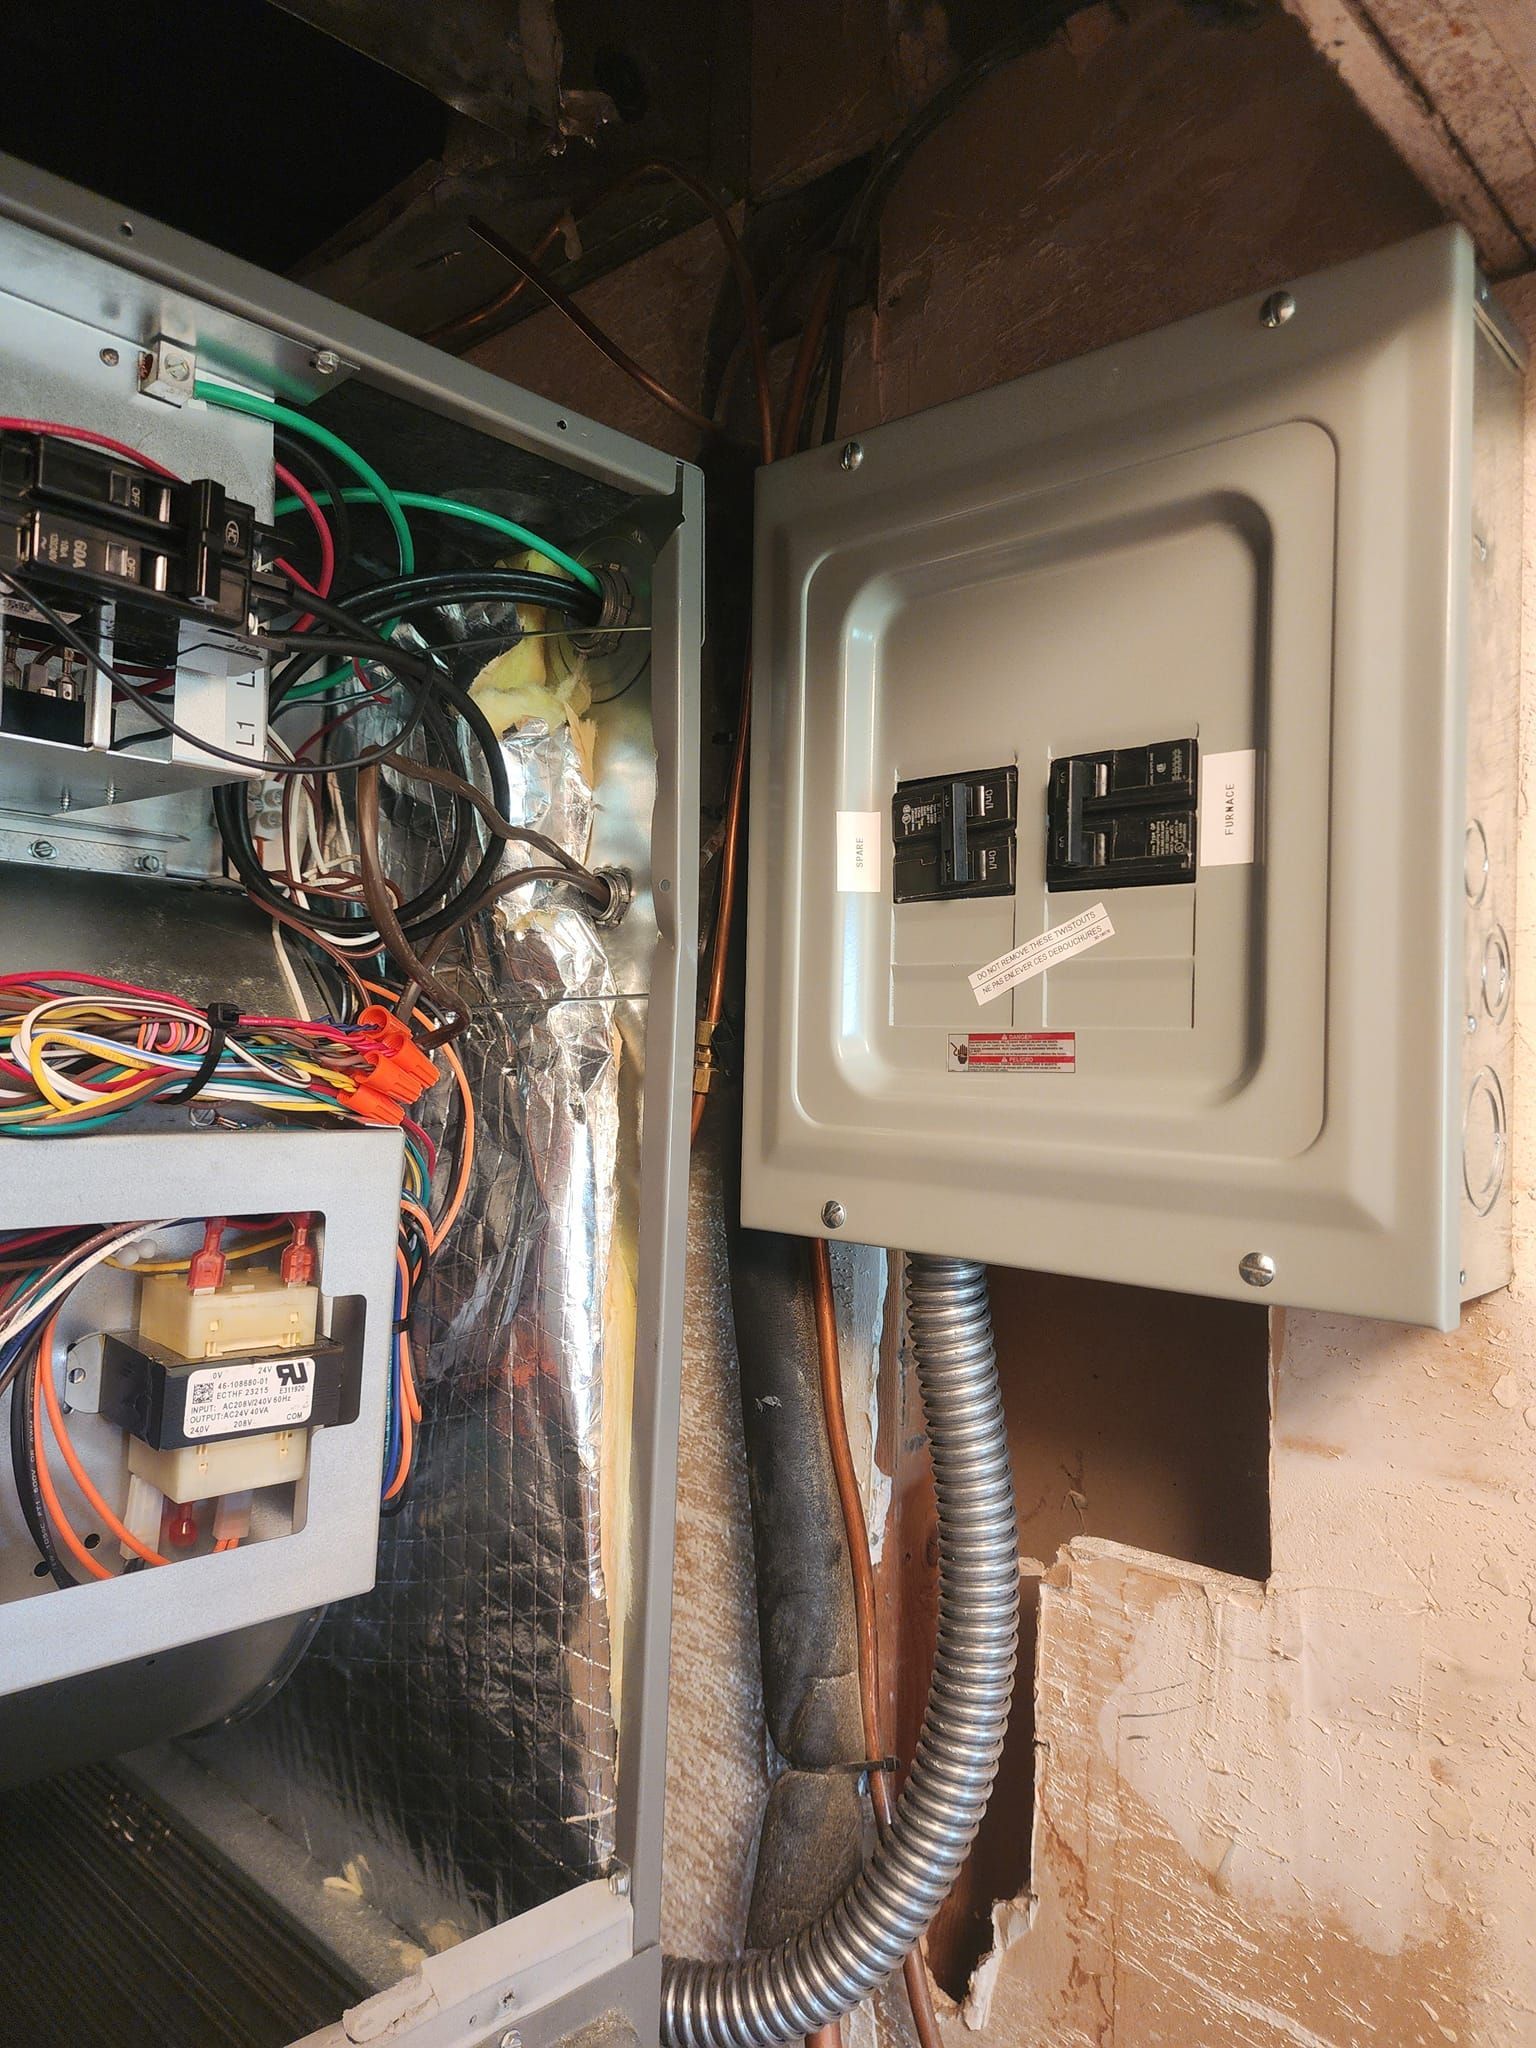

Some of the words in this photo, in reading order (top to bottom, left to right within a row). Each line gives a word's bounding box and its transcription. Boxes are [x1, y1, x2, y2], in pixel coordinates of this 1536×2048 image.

[131, 487, 141, 508] OFF
[73, 540, 88, 568] 60A
[128, 557, 137, 578] OFF
[236, 671, 256, 688] L
[236, 721, 256, 746] L1
[1224, 784, 1235, 836] FURNACE
[856, 837, 864, 868] SPARE
[977, 971, 988, 981] DO
[987, 963, 1001, 974] NOT
[1001, 946, 1030, 966] REMOVE
[1030, 934, 1054, 950] THESE
[1053, 911, 1096, 938] TWISTOUTS
[982, 985, 993, 994] NE
[992, 978, 1005, 989] PAS
[1004, 961, 1034, 982] ENLEVER
[1033, 953, 1048, 966] CES
[1048, 925, 1103, 958] DEBOUCHURES
[258, 1366, 272, 1374] 24V
[217, 1390, 243, 1399] ECTHF
[245, 1386, 269, 1396] 23215
[191, 1405, 216, 1414] INPUT:
[287, 1412, 303, 1420] COM
[190, 1425, 210, 1434] 240V
[233, 1419, 253, 1428] 208V
